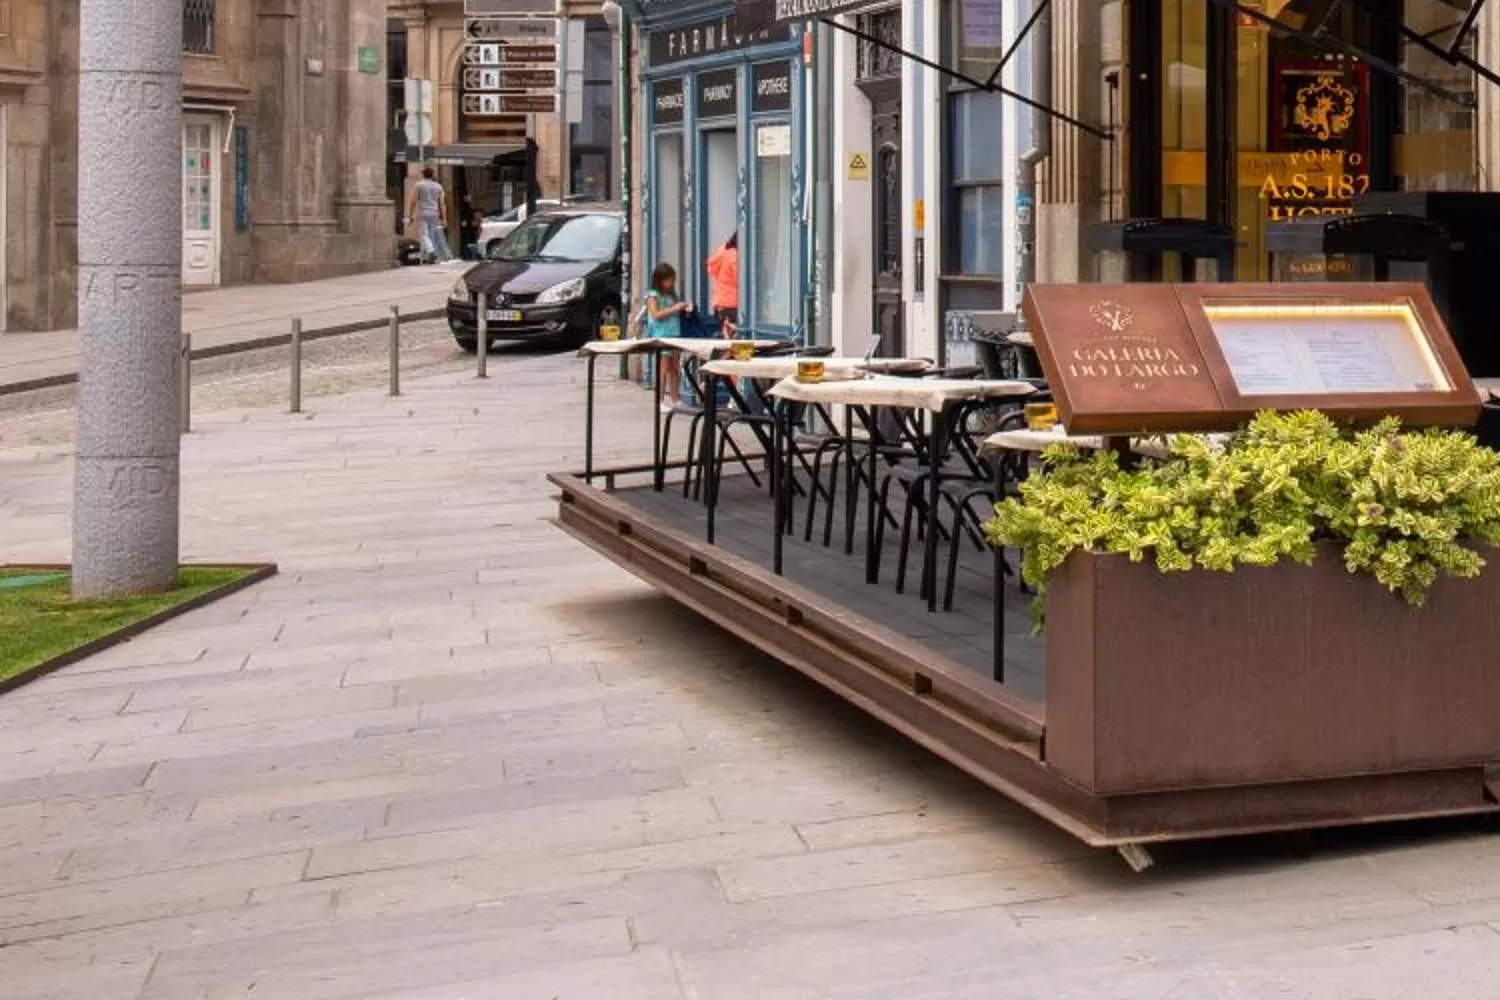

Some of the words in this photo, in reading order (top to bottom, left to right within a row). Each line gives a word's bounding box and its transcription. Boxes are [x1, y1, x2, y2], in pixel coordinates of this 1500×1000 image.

[1289, 147, 1361, 165] PORTO
[1258, 173, 1315, 200] A.S.
[1072, 347, 1181, 361] GALERIA
[1070, 363, 1107, 377] DO
[1113, 363, 1199, 377] LARGO
